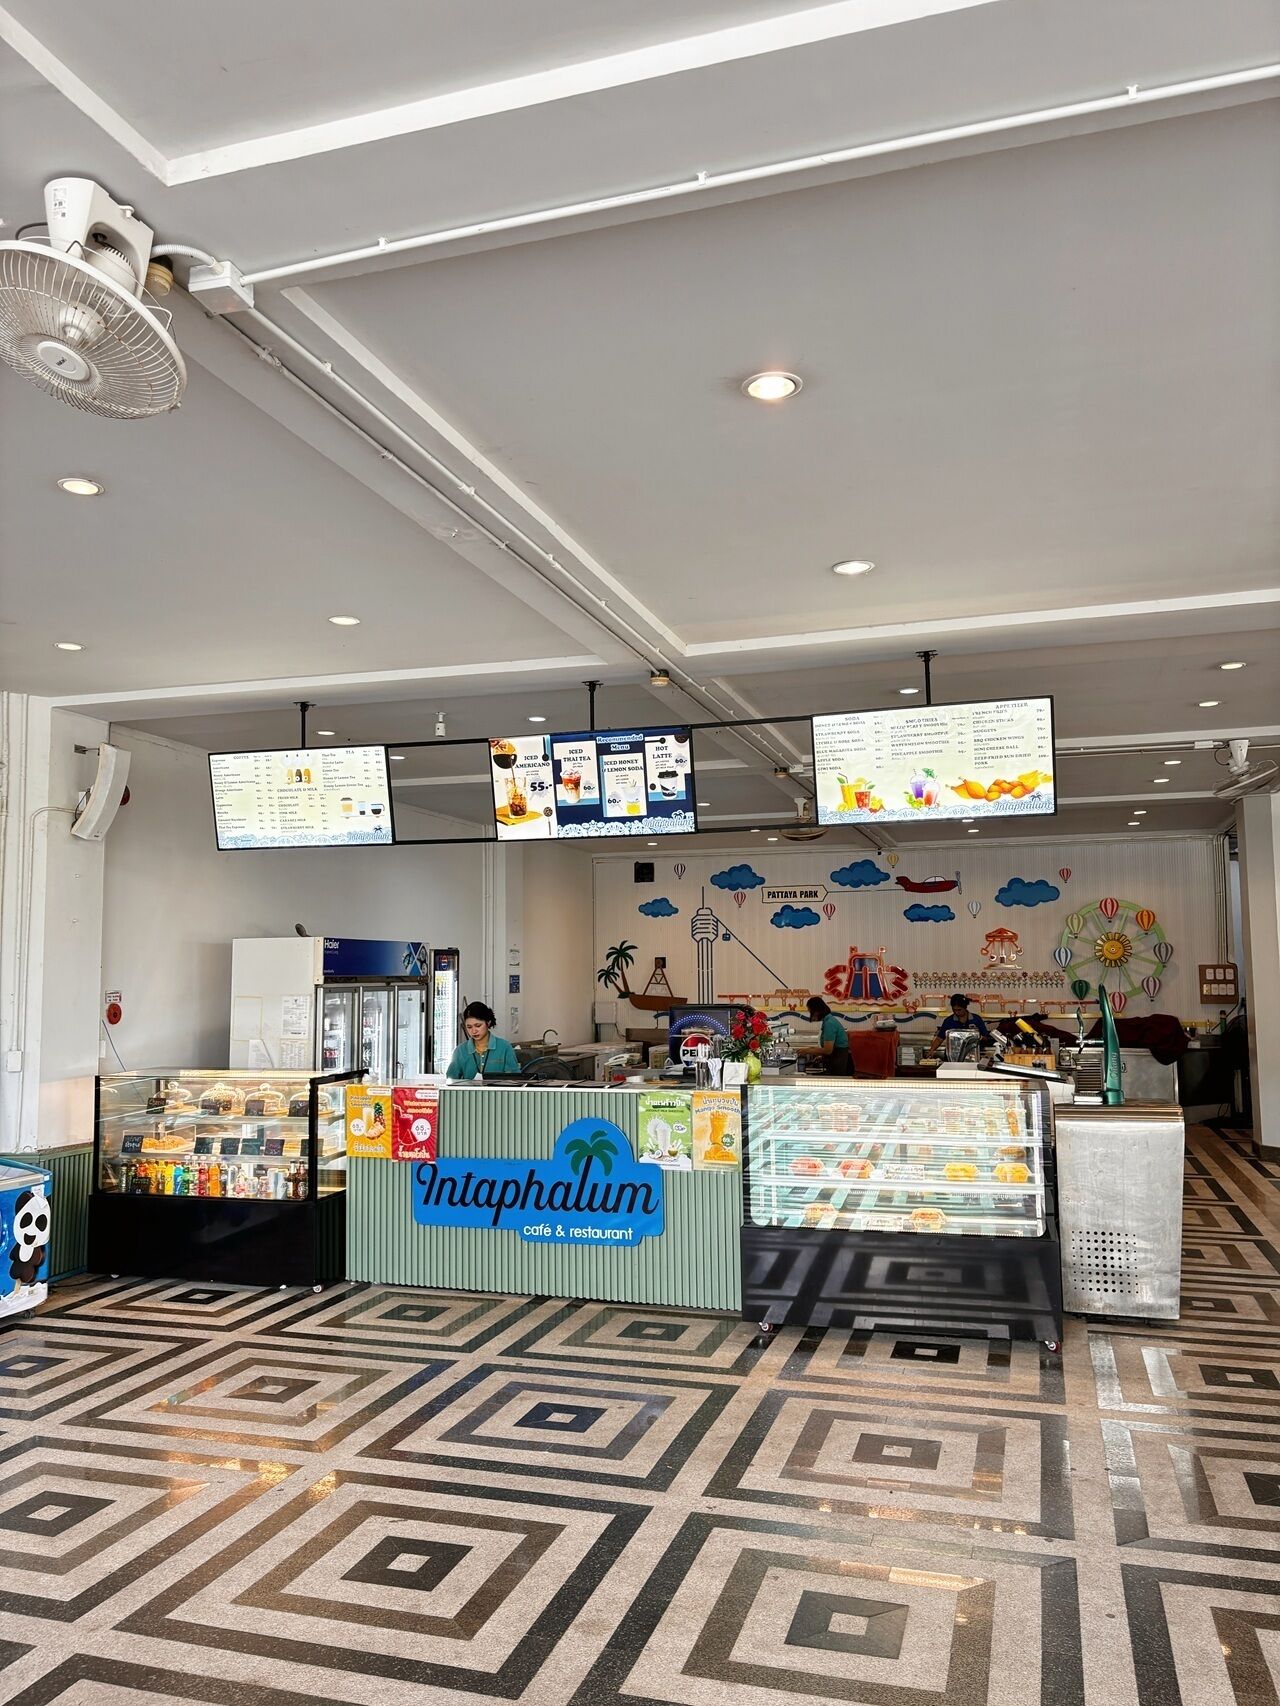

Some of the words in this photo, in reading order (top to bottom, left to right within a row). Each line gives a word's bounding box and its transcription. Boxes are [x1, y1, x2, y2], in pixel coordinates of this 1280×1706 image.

[596, 734, 643, 743] Recommended
[324, 940, 339, 949] Haier
[695, 1106, 715, 1114] Mango
[416, 1155, 660, 1226] Intaphalum
[523, 1224, 551, 1237] café
[556, 1225, 565, 1237] &
[569, 1226, 633, 1240] restaurant
